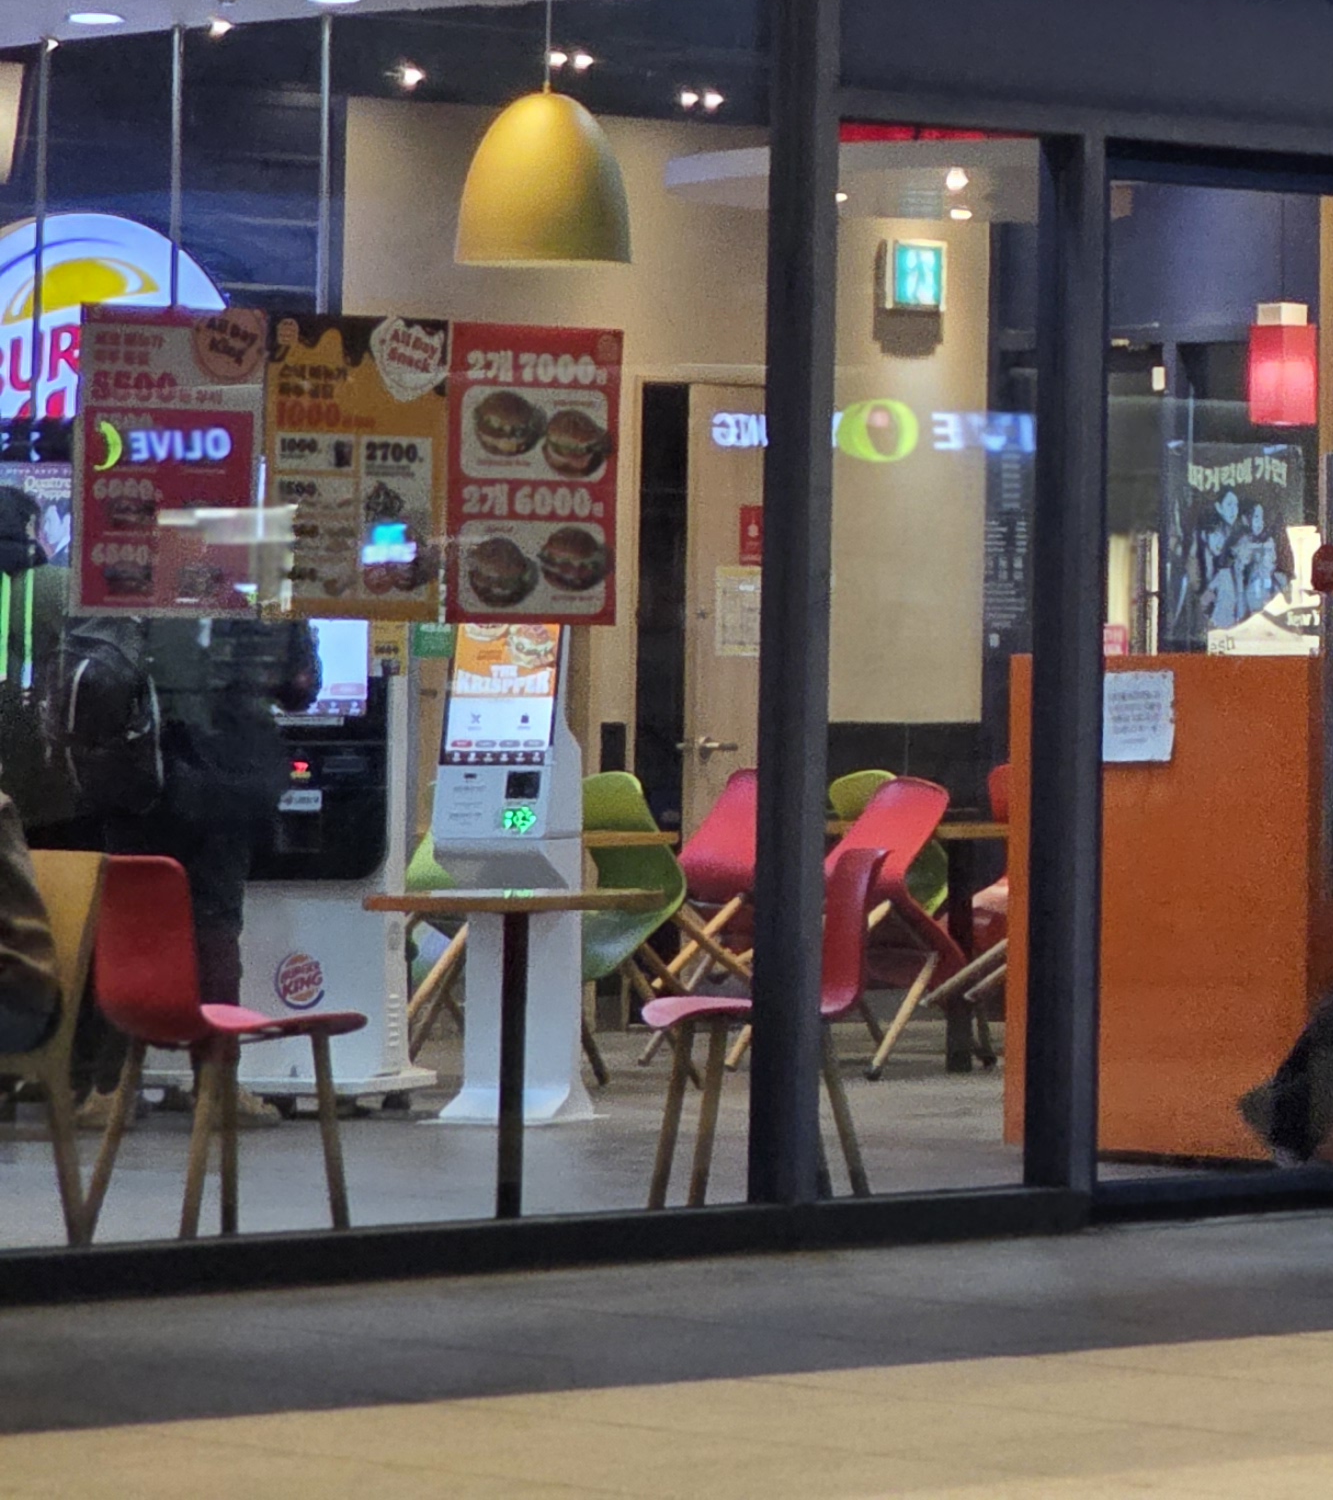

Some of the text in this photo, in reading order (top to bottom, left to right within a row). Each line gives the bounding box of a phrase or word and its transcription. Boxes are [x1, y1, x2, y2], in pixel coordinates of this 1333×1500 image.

[466, 350, 514, 383] 2개
[461, 482, 509, 517] 2개
[281, 971, 323, 1000] KING
